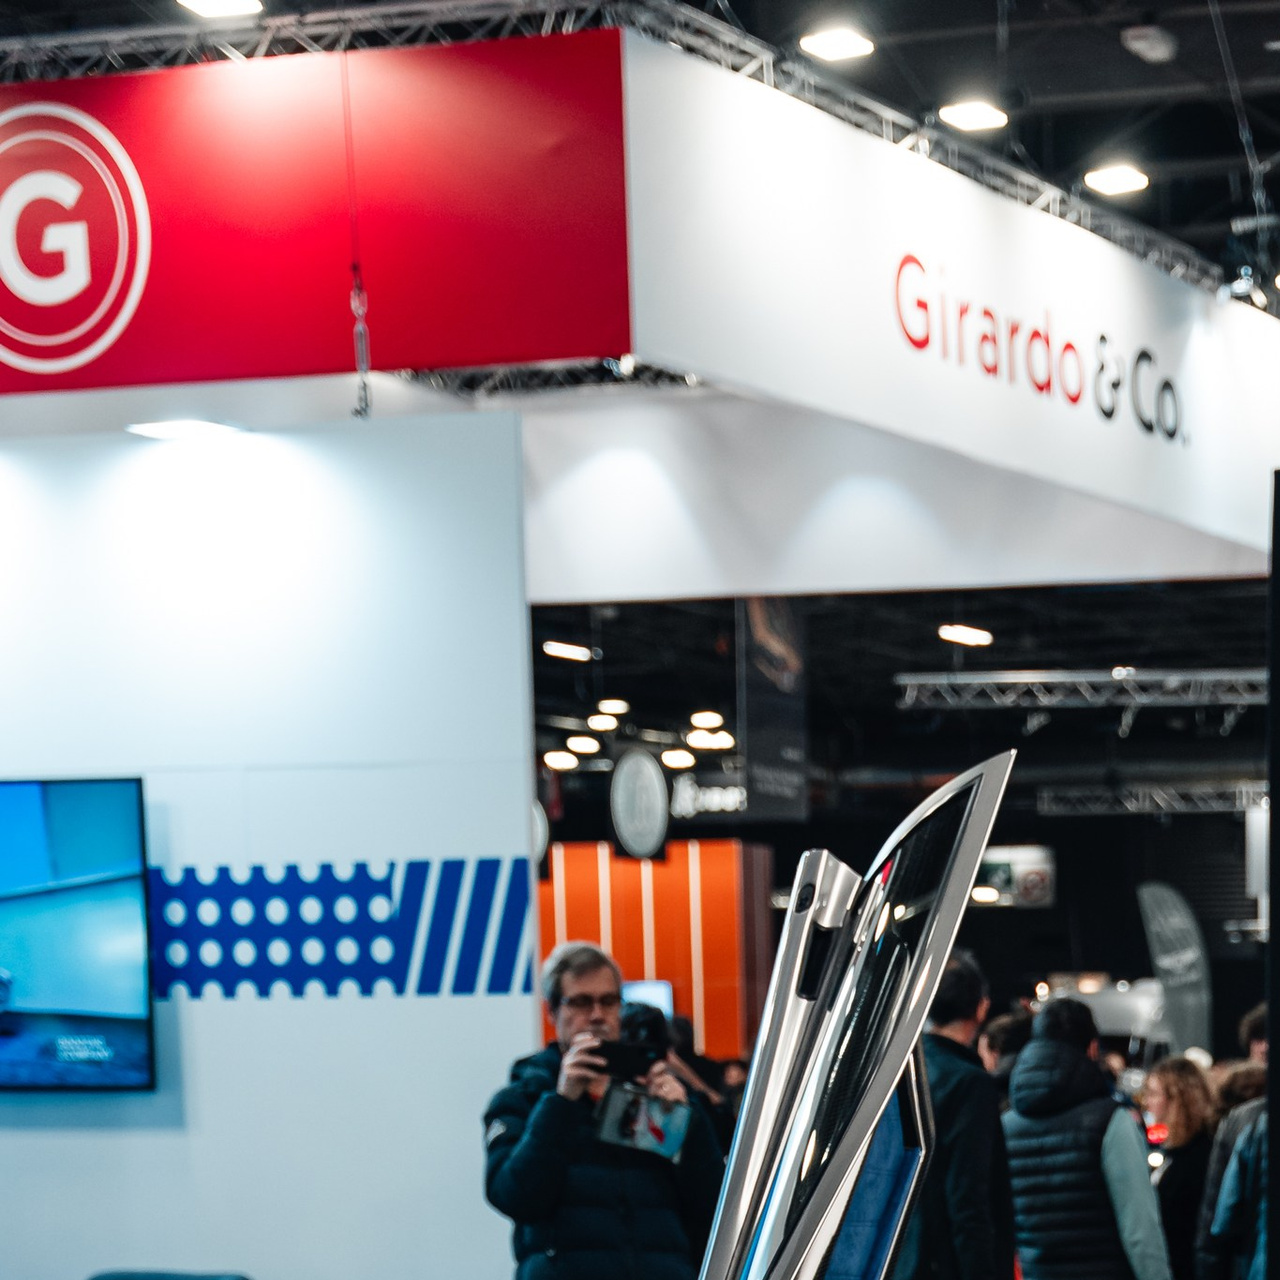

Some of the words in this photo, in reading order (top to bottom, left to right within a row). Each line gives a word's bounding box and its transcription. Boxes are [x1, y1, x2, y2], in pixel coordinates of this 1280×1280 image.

[0, 170, 92, 307] G
[895, 253, 1085, 405] Girardo
[1094, 333, 1121, 420] &
